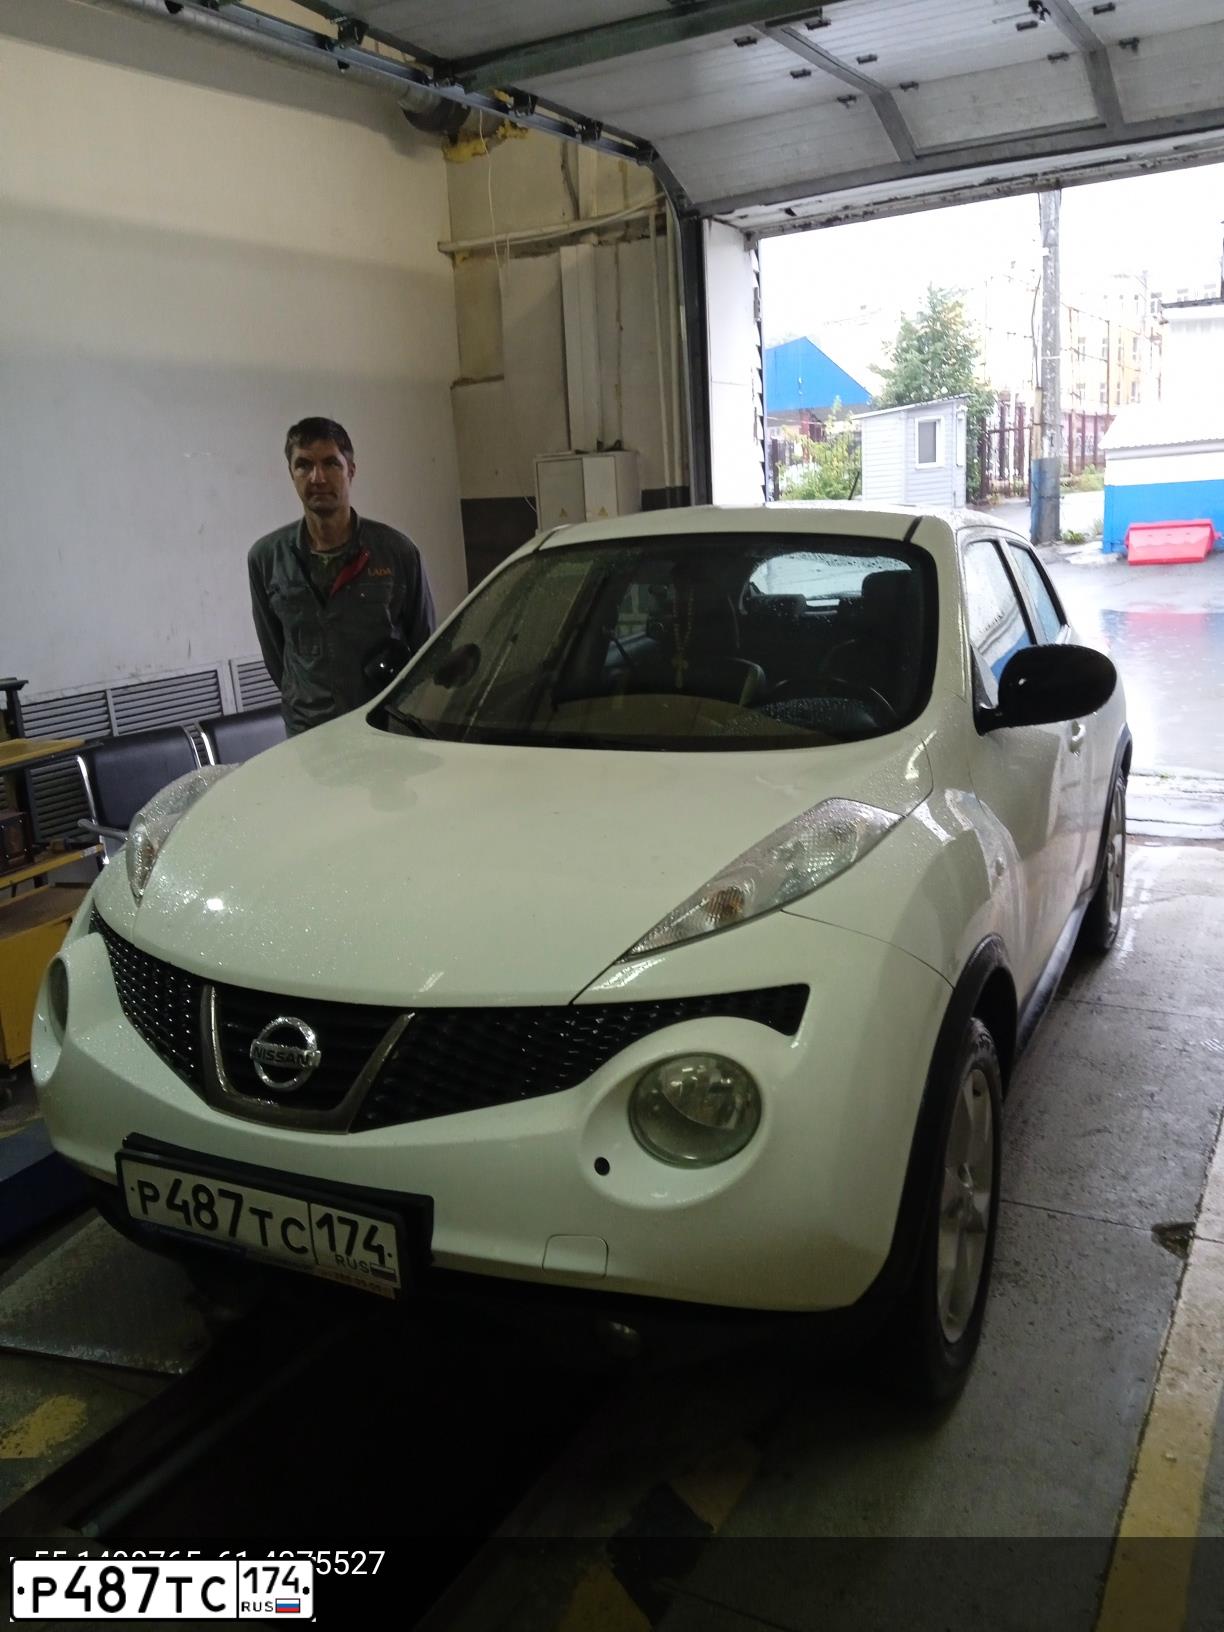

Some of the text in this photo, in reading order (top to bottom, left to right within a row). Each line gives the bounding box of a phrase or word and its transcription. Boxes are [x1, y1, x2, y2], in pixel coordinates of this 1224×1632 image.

[253, 1045, 310, 1067] NISSAN
[316, 1212, 387, 1266] 174
[335, 1254, 371, 1274] RUS
